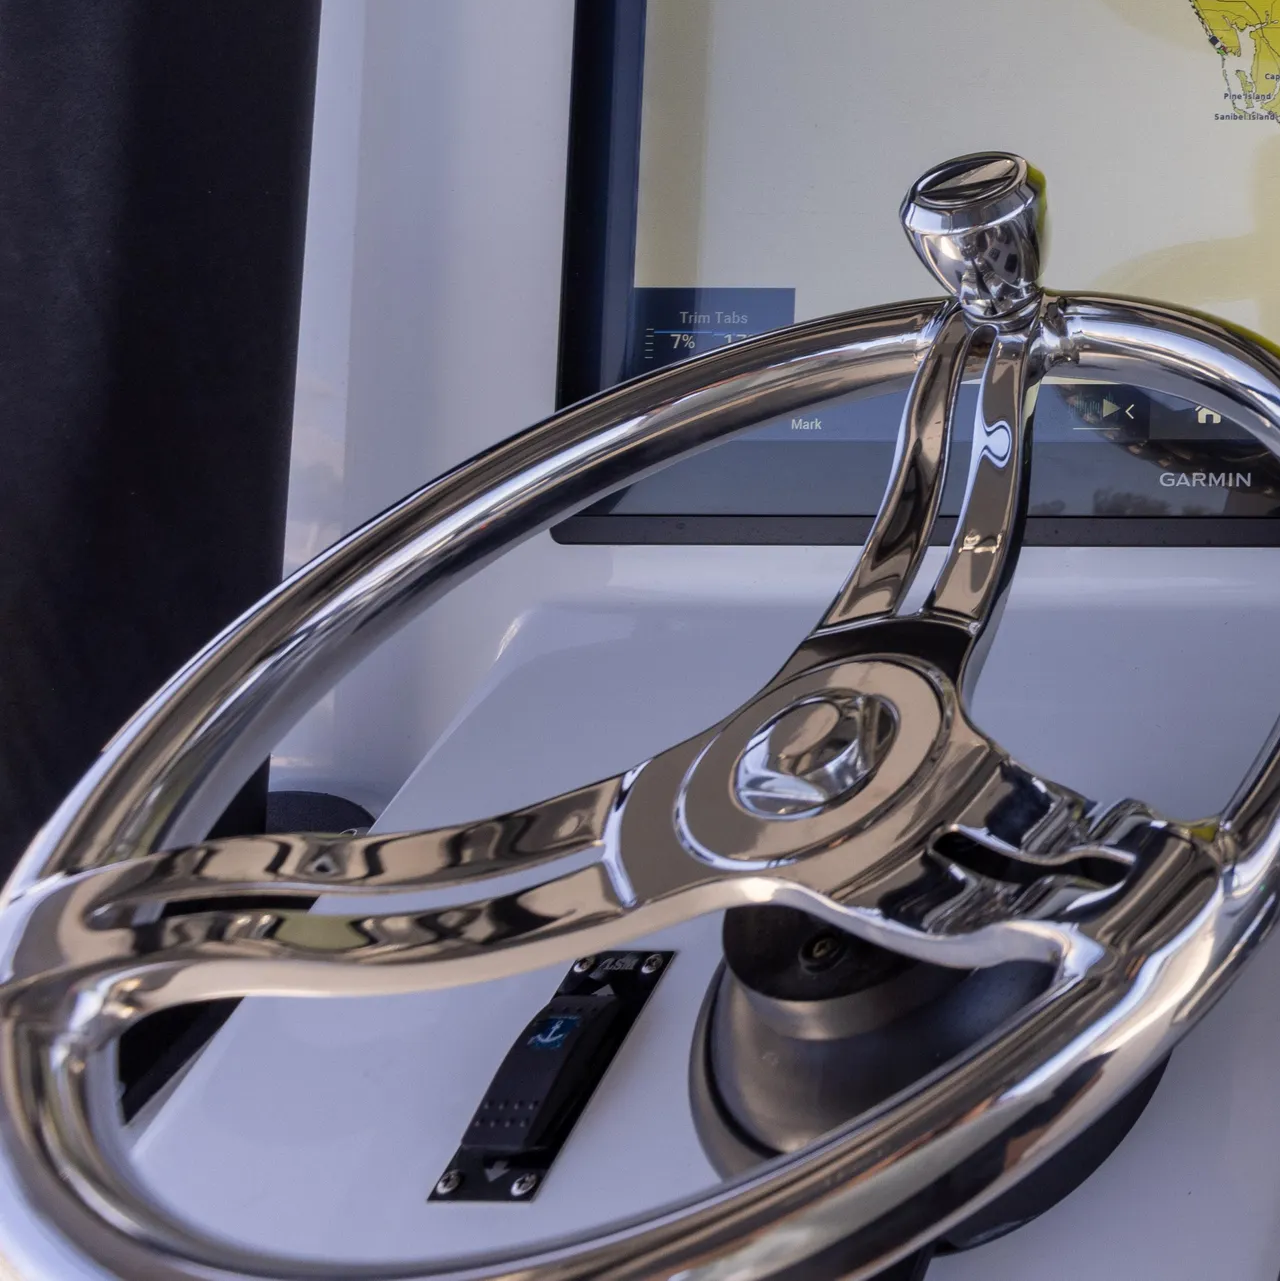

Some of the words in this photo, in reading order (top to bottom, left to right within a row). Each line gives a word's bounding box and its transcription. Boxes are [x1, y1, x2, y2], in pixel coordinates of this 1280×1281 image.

[680, 311, 710, 324] Trim
[714, 312, 748, 324] Tabs
[670, 334, 695, 349] 7%
[791, 419, 822, 430] Mark
[1159, 472, 1251, 488] GARMIN
